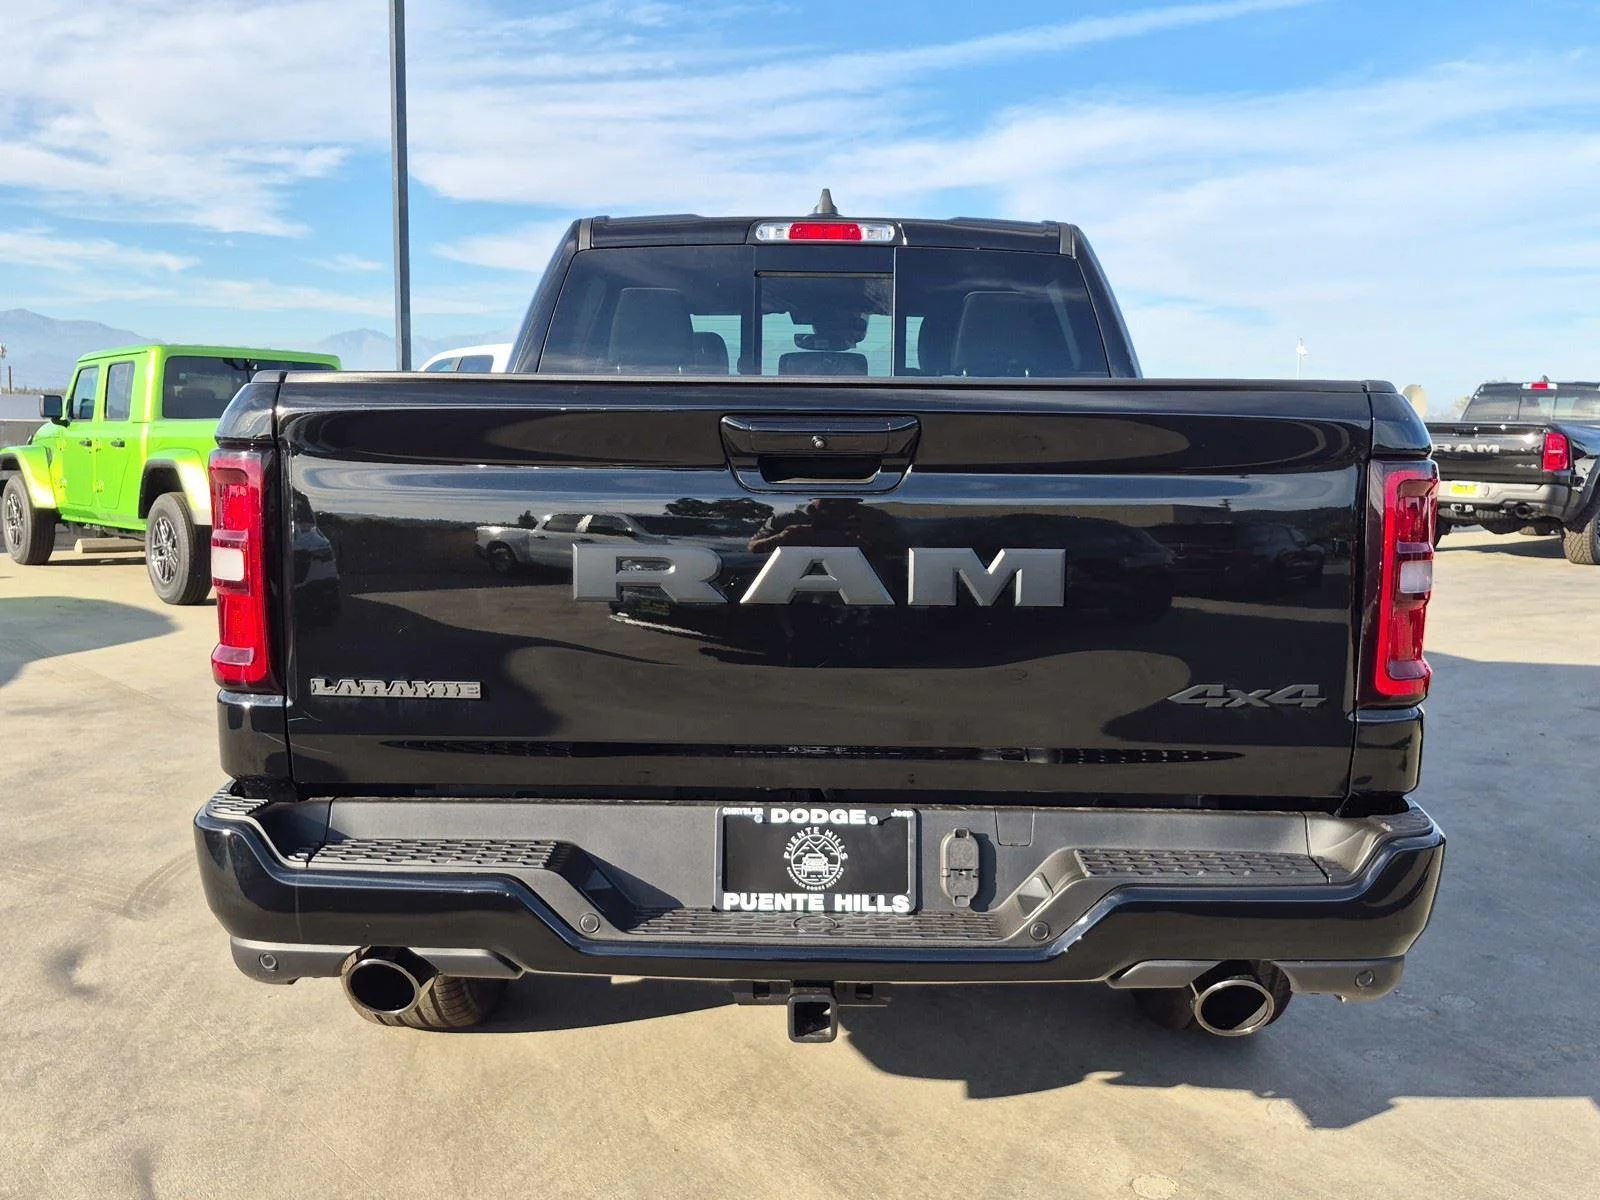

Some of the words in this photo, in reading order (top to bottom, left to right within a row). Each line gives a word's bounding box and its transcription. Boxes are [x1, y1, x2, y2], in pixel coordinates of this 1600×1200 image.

[1432, 443, 1500, 454] RAM
[572, 543, 1066, 607] RAM
[310, 678, 481, 699] LARAMIE
[1167, 684, 1327, 708] 4x4
[722, 807, 764, 816] CHRYSLER
[770, 808, 867, 824] DODGE
[783, 826, 820, 859] PUENTE
[824, 829, 849, 860] HILLS
[722, 892, 825, 911] PUENTE
[834, 894, 911, 913] HILLS
